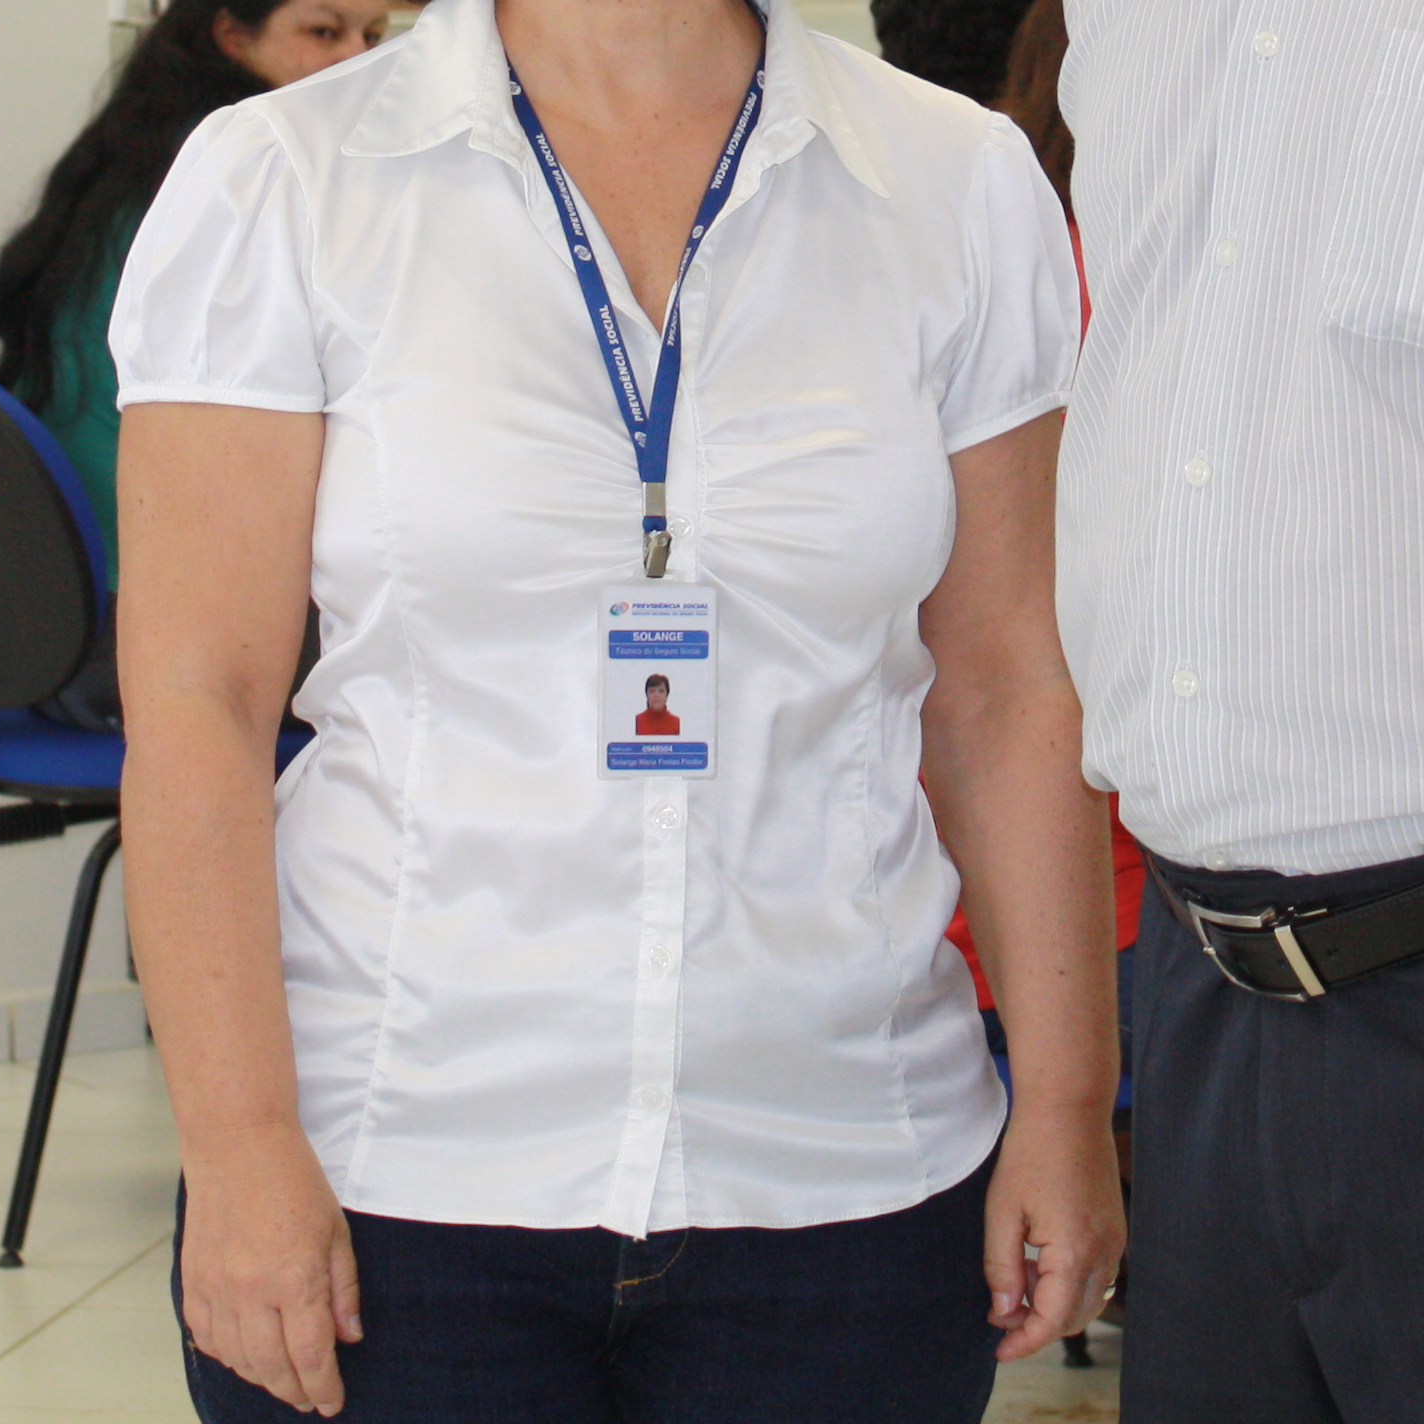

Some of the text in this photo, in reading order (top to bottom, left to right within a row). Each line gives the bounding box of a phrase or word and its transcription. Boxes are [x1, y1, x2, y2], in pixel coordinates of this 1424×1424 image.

[536, 132, 557, 168] SOCIAL
[710, 91, 758, 189] PREVIDÊNCIA SOCIAL
[599, 304, 645, 422] PREVIDÊNCIA SOCIAL
[632, 631, 684, 642] SOLANGE
